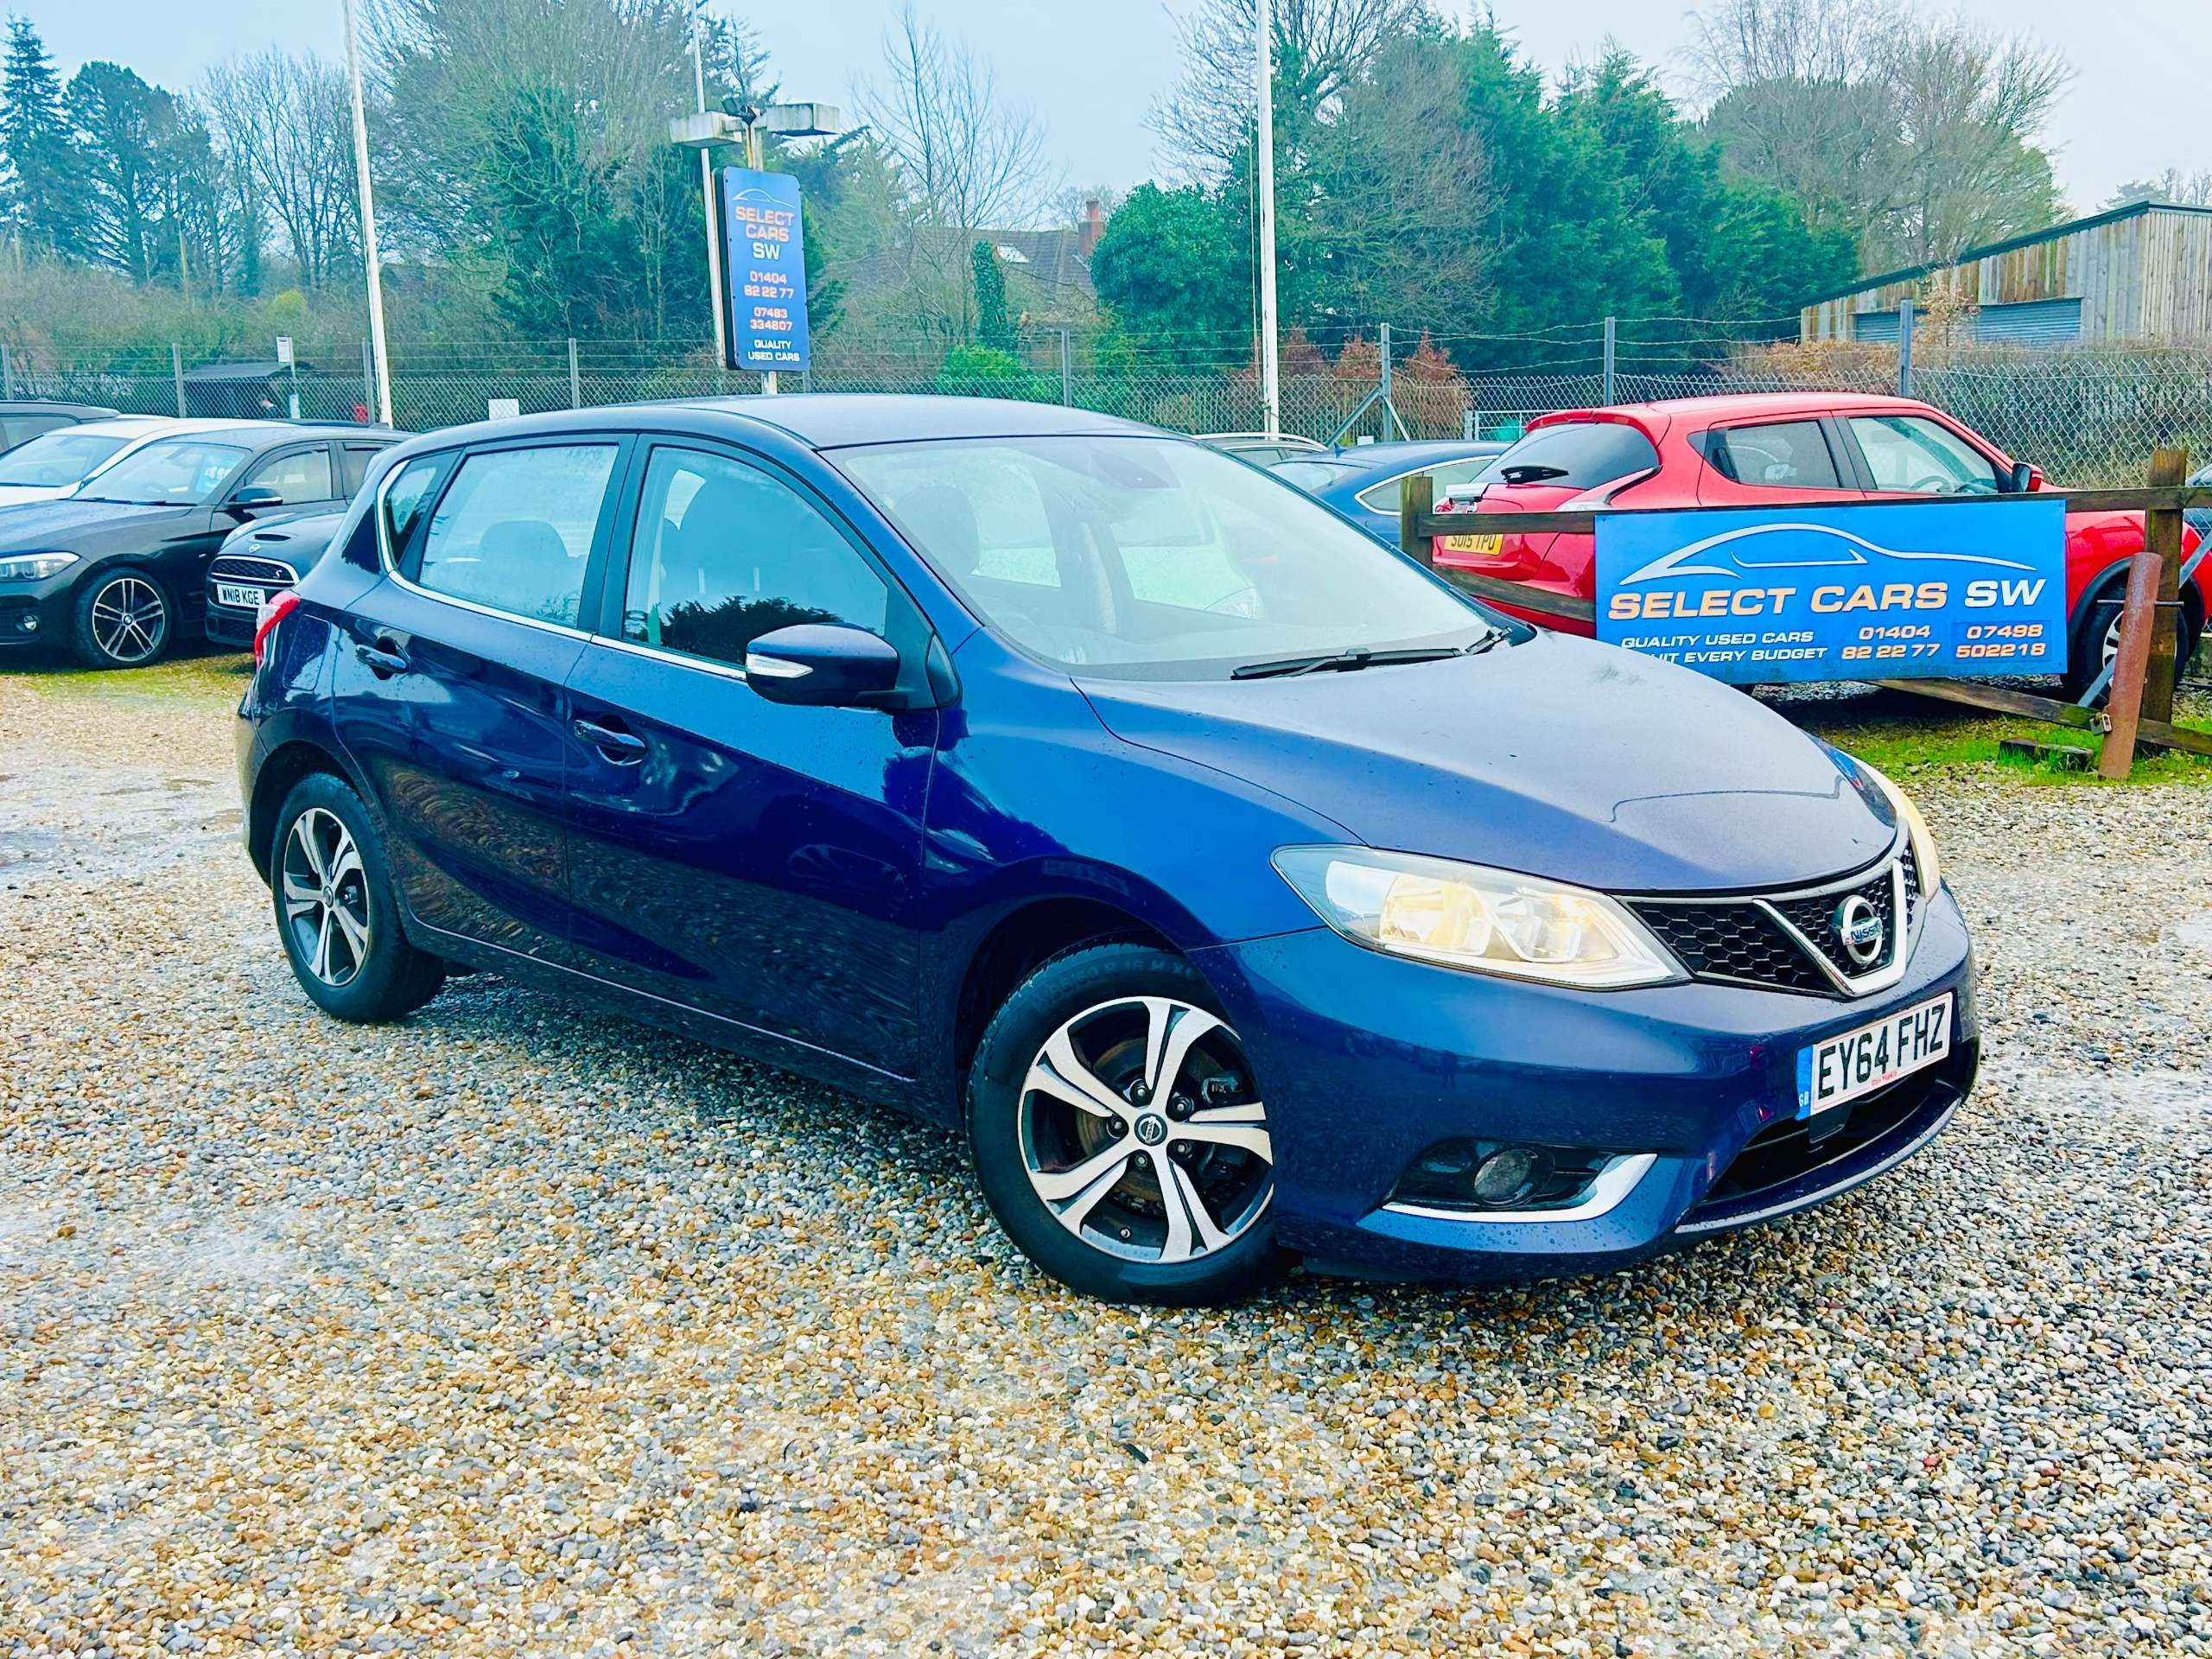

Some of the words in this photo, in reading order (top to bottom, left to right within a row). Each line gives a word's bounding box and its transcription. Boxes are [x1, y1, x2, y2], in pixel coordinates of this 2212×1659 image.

[735, 206, 795, 226] SELECT
[746, 223, 790, 243] CARS
[753, 241, 780, 260] SW
[750, 270, 787, 284] 01404
[761, 286, 778, 298] 22
[779, 288, 794, 299] 77
[753, 339, 791, 350] QUALITY
[747, 351, 773, 360] USED
[775, 352, 800, 362] CARS
[221, 588, 241, 603] WN18
[241, 588, 260, 605] KGE
[1608, 587, 1796, 620] SELECT
[1810, 582, 1948, 613] CARS
[1964, 578, 2047, 608] SW
[1621, 635, 1700, 649] QUALITY
[1705, 632, 1757, 646] USED
[1761, 631, 1815, 645] CARS
[1859, 625, 1930, 640] 01404
[1966, 624, 2044, 639] 07498
[1684, 650, 1747, 664] EVERY
[1751, 647, 1828, 661] BUDGET
[1841, 645, 1872, 660] 82
[1875, 645, 1907, 658] 22
[1911, 643, 1941, 658] 77
[1955, 642, 2047, 658] 502218
[1851, 920, 1882, 940] NISS
[1817, 1024, 1890, 1100] EY64
[1897, 1002, 1946, 1068] FHZ
[1798, 1090, 1809, 1107] GB
